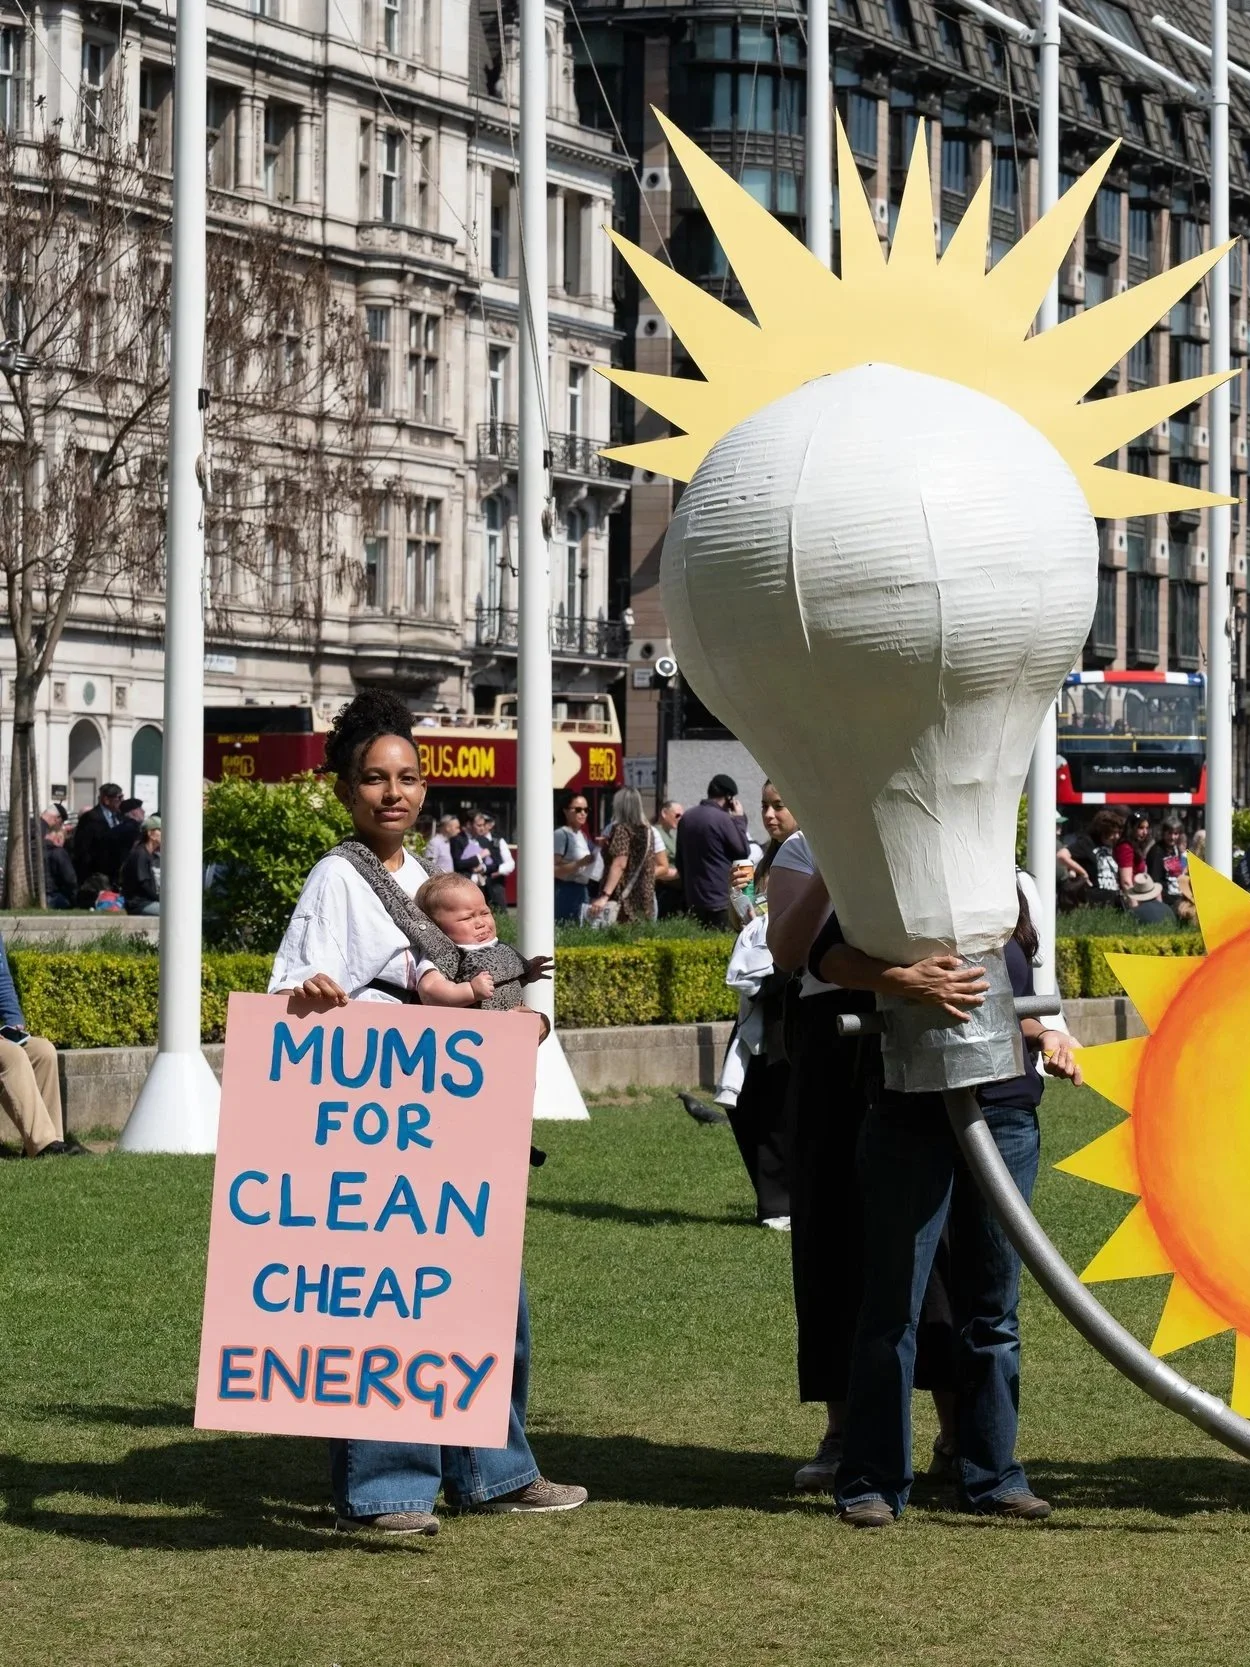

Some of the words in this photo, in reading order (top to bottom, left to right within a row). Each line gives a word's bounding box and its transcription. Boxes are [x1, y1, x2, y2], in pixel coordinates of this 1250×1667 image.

[269, 1021, 484, 1098] MUMS
[315, 1101, 434, 1151] FOR
[229, 1170, 490, 1237] CLEAN
[252, 1263, 451, 1319] CHEAP
[217, 1344, 499, 1419] ENERGY
